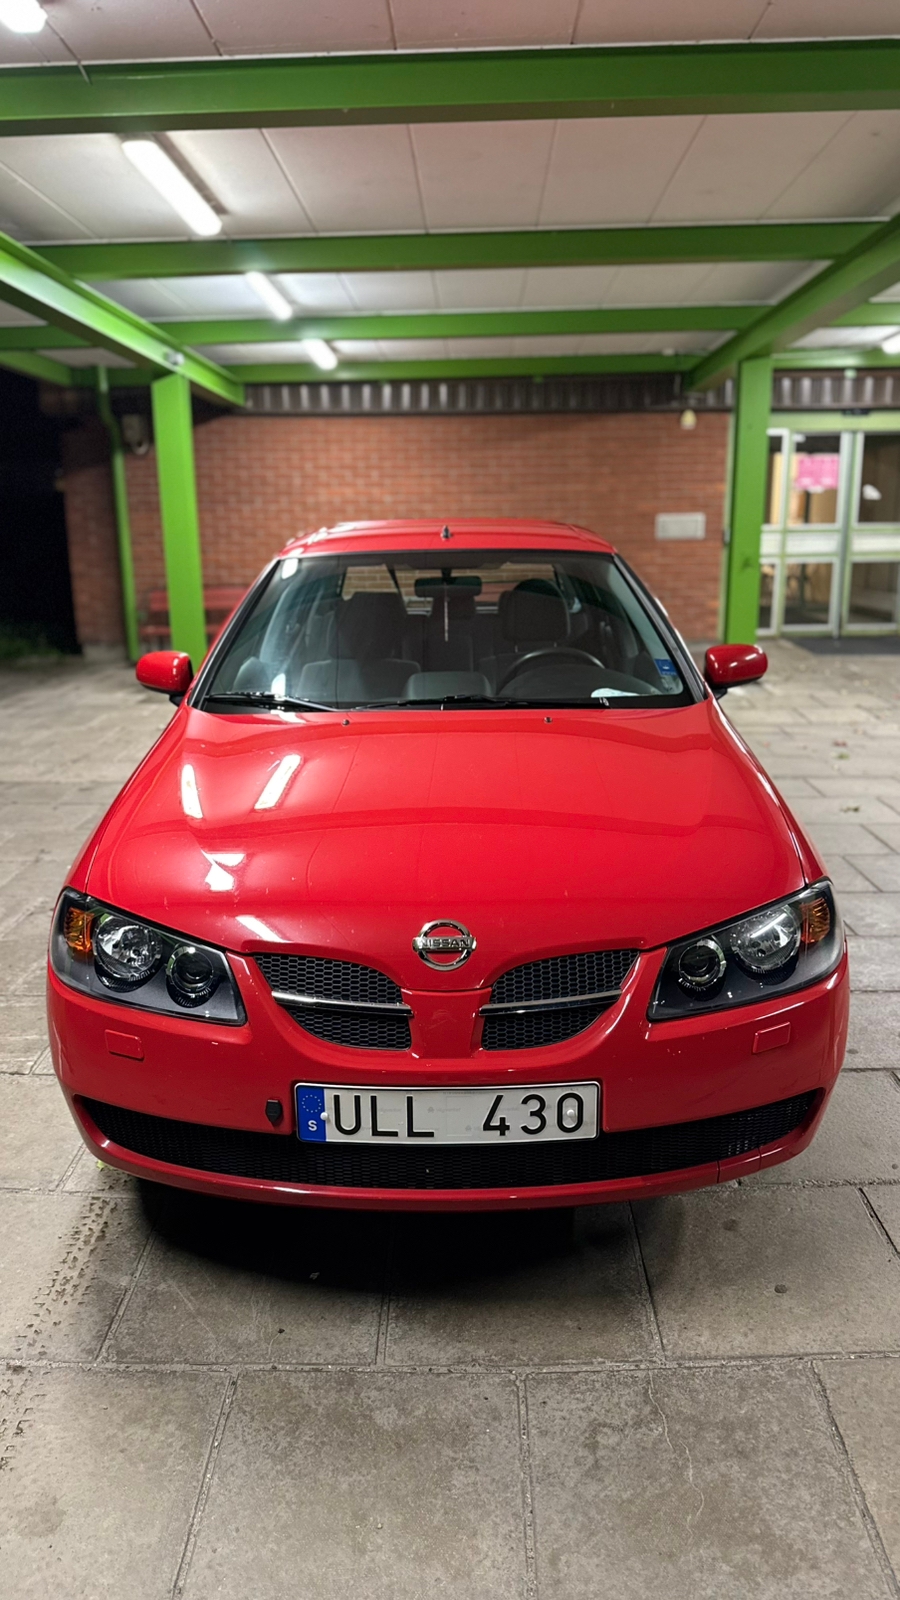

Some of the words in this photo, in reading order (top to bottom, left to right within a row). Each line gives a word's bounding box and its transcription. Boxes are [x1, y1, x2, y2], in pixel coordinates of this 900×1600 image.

[420, 939, 469, 948] NISSAN
[333, 1094, 435, 1138] ULL
[482, 1092, 584, 1136] 430
[307, 1120, 317, 1132] S
